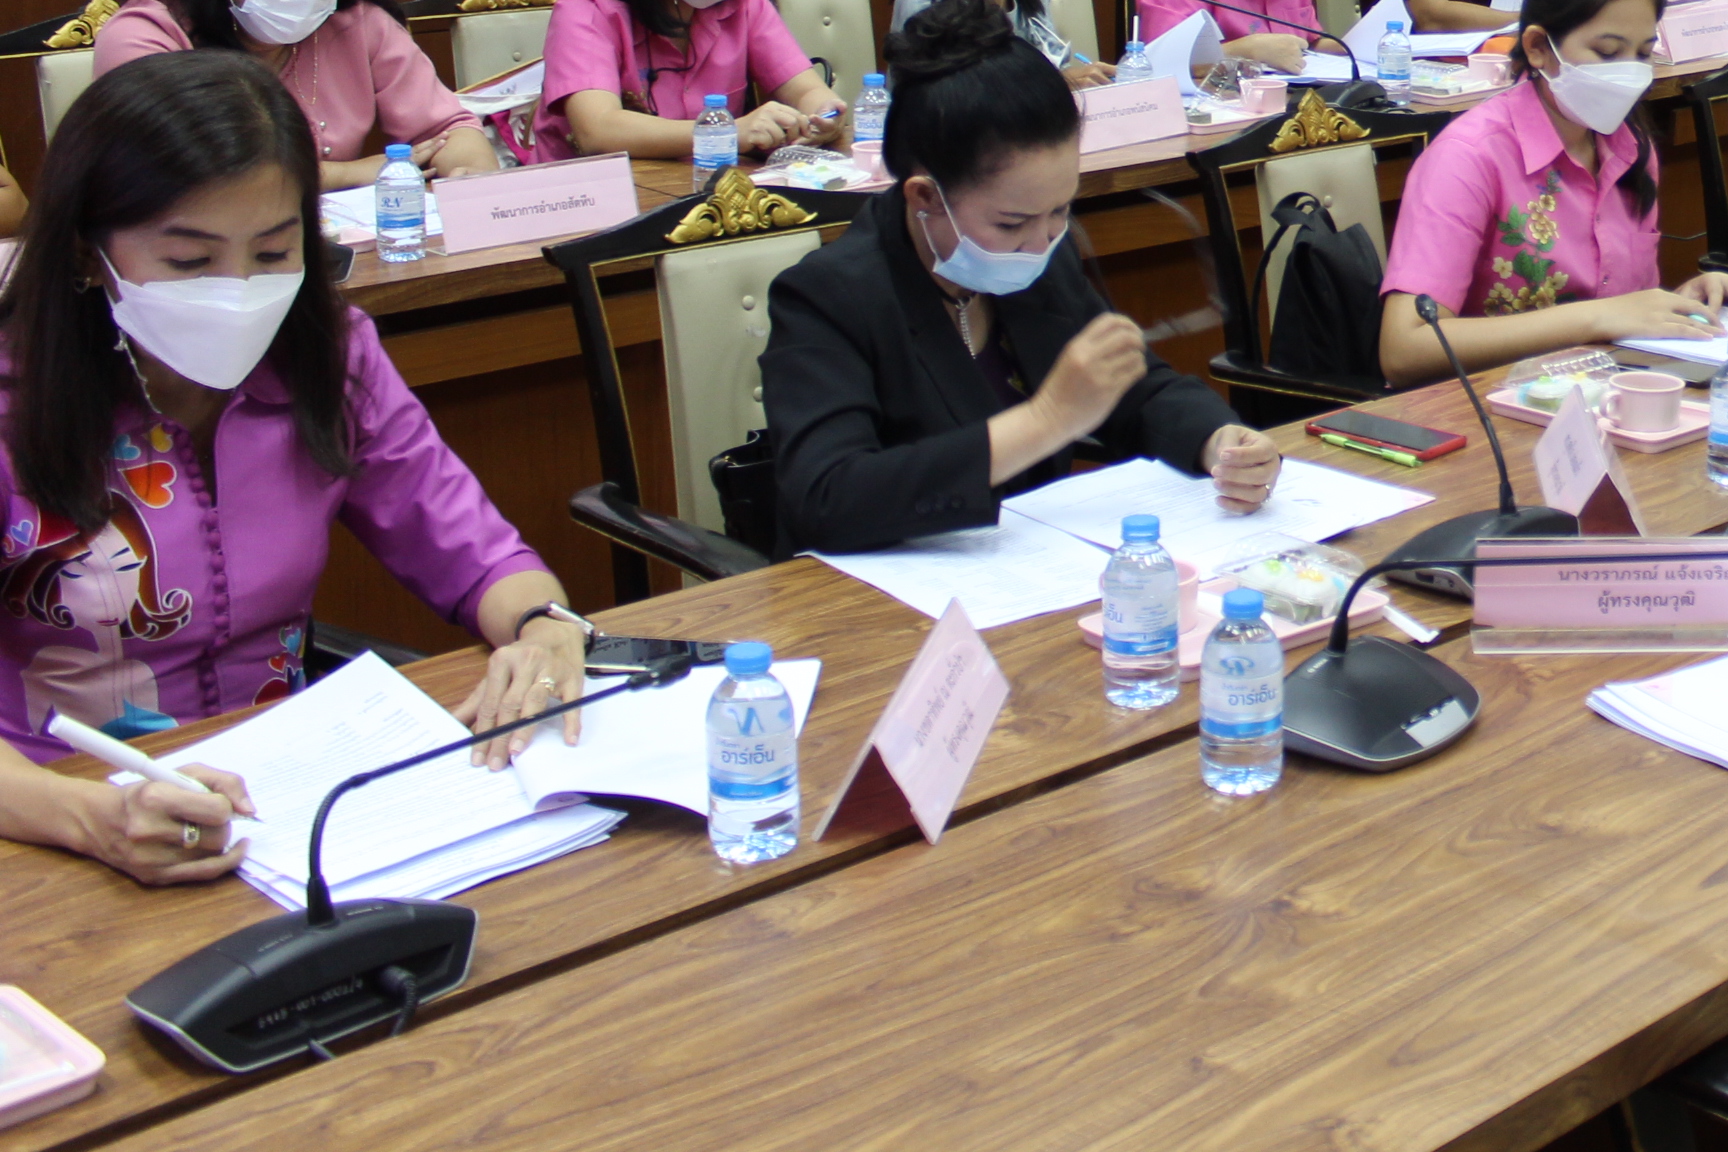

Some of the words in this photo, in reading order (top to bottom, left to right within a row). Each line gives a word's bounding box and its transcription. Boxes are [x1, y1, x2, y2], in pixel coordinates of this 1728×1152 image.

[490, 194, 595, 220] พัฒนาการอำเภอสัตหีบ
[1558, 565, 1659, 582] นางวราภรณ์
[1598, 590, 1696, 614] ผู้ทรงคุณวุฒิ
[1228, 684, 1277, 706] อาร์เอ็น
[721, 743, 775, 765] อาร์เอ็น
